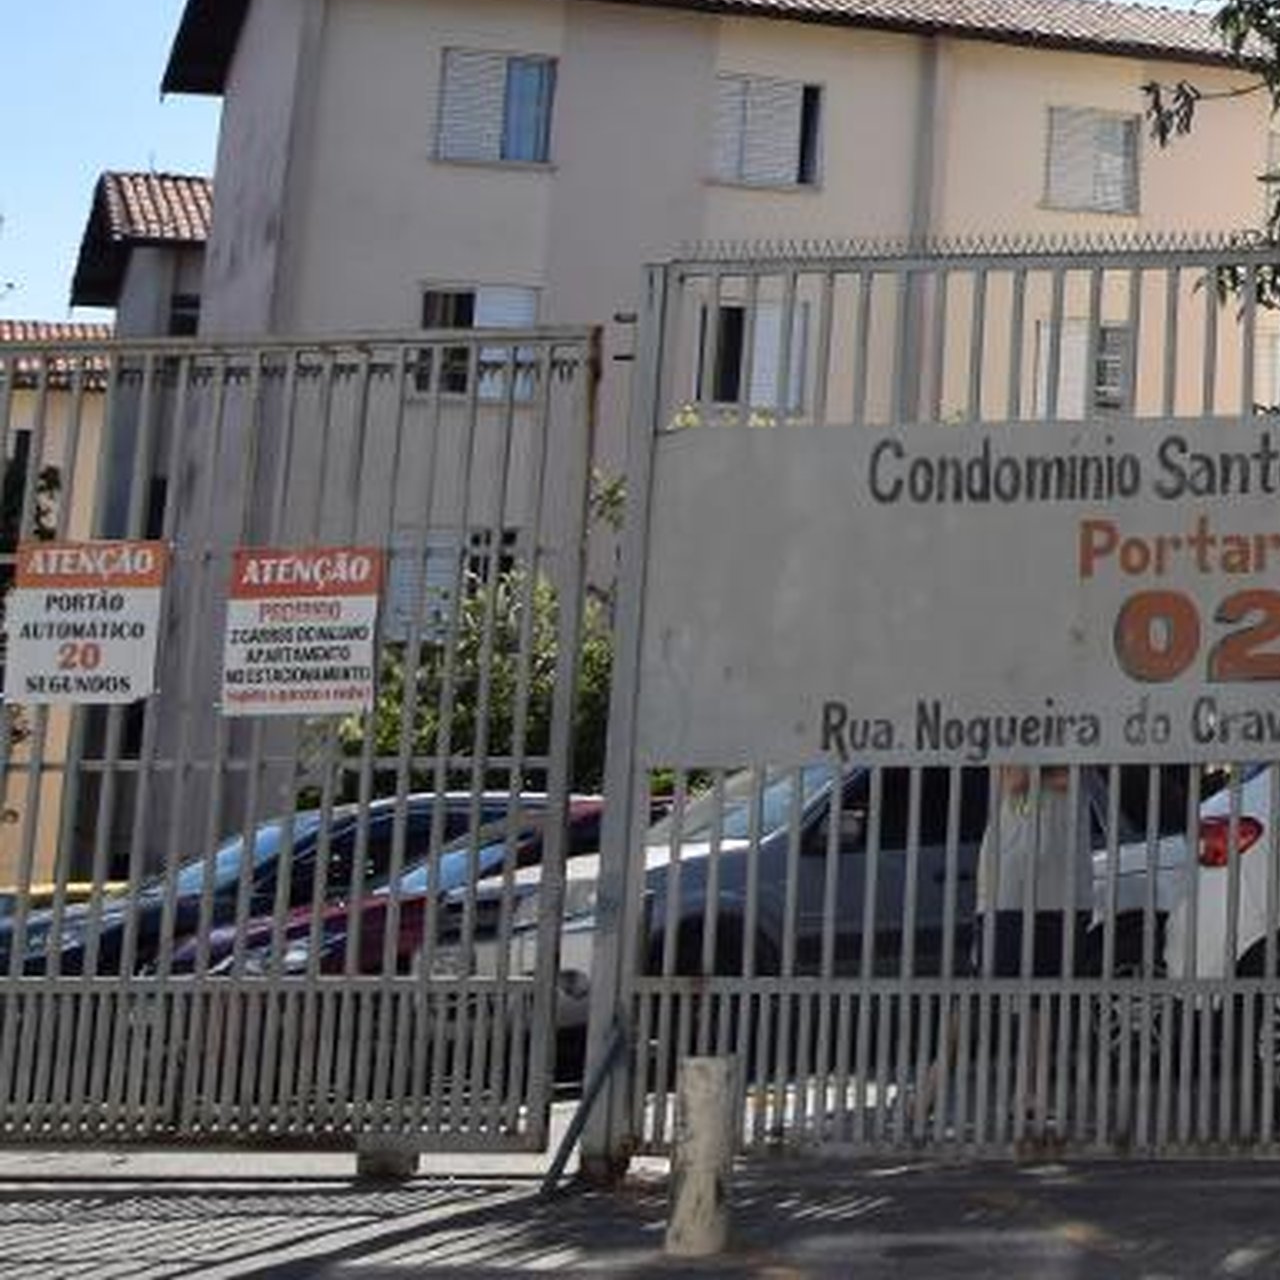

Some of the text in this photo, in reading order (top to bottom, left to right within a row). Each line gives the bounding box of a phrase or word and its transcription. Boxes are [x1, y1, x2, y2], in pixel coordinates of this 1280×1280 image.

[868, 435, 1141, 504] Condomínio
[26, 547, 153, 582] ATENÇÃO
[241, 553, 372, 592] ATENÇÃO
[46, 591, 125, 613] PORTÃO
[58, 642, 101, 671] 20
[26, 674, 131, 695] SEGUNDOS
[915, 696, 1099, 762] Nogueira
[1122, 696, 1171, 747] do
